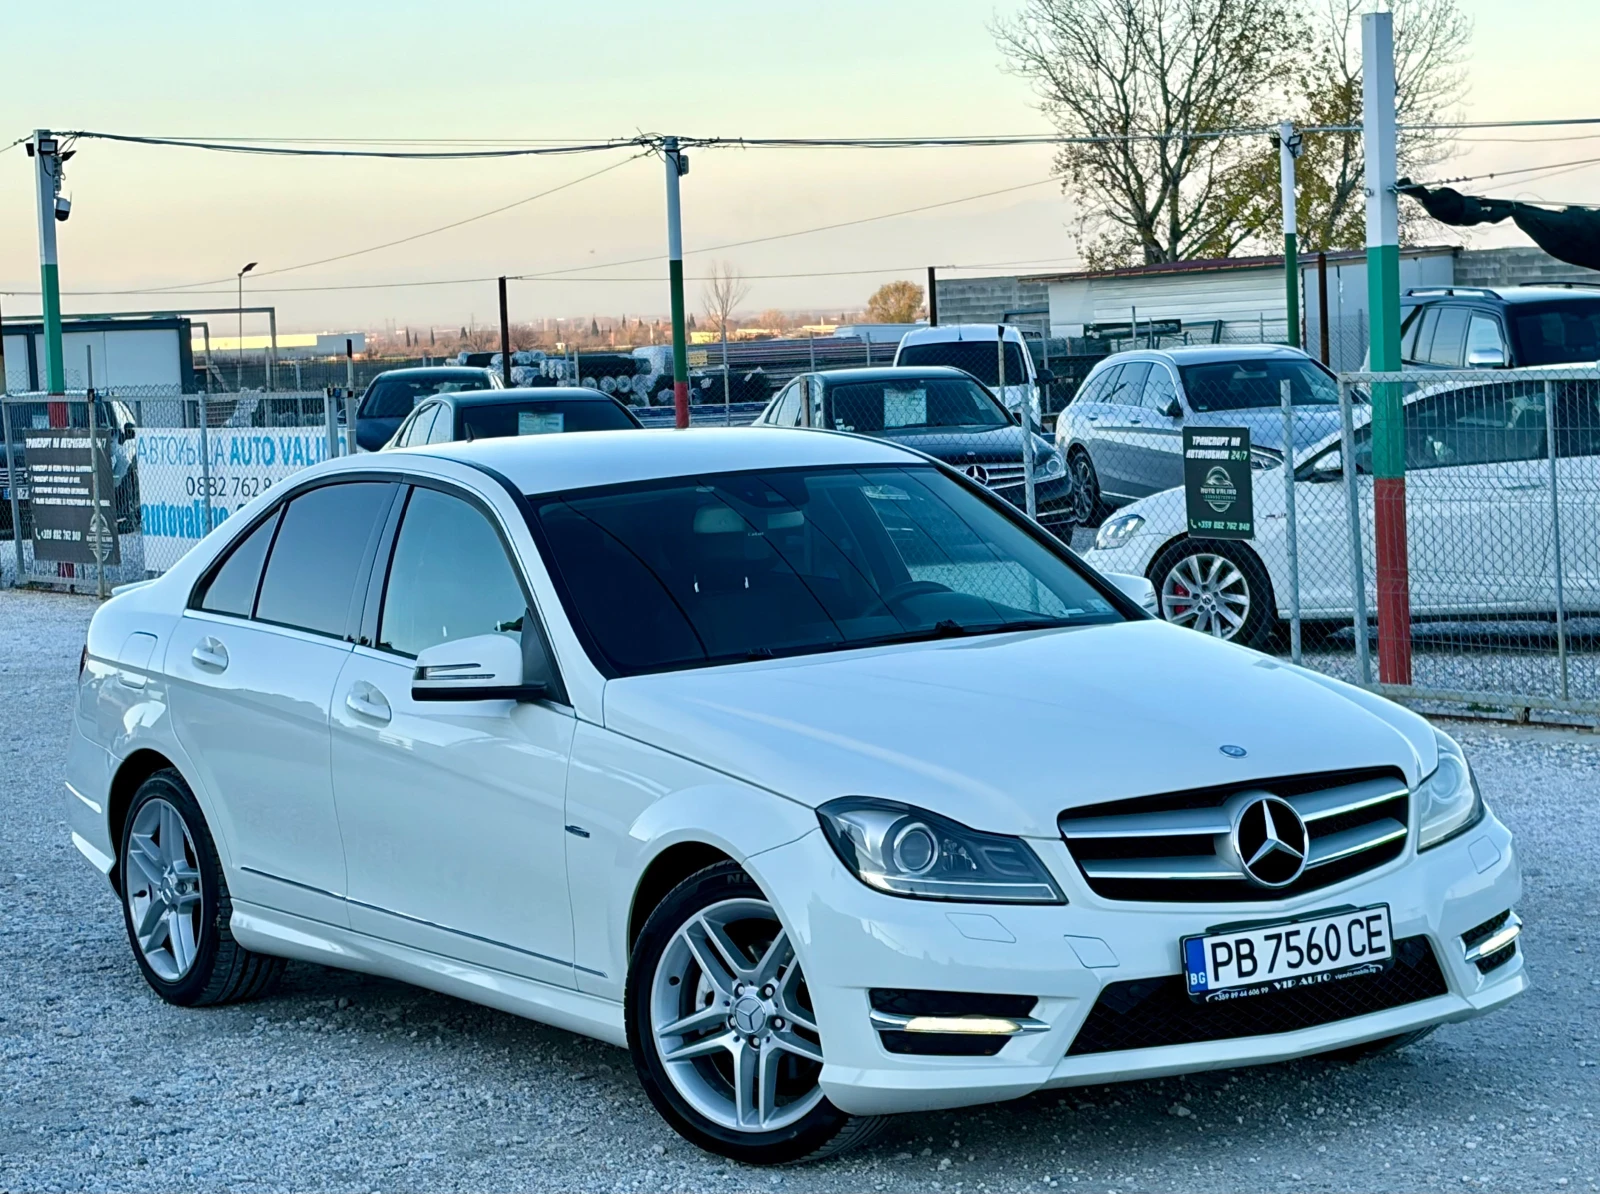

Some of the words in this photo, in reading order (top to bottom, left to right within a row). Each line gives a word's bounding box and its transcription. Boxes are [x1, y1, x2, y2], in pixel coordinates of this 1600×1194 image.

[230, 436, 275, 466] AUTO
[1230, 450, 1248, 461] 24/7
[186, 476, 226, 497] 0882
[232, 477, 260, 498] 762
[1210, 938, 1258, 982] PB
[1264, 923, 1341, 974] 7560
[1348, 914, 1386, 957] CE
[1190, 972, 1206, 985] BG
[1273, 979, 1296, 990] VIP
[1299, 972, 1332, 986] AUTO
